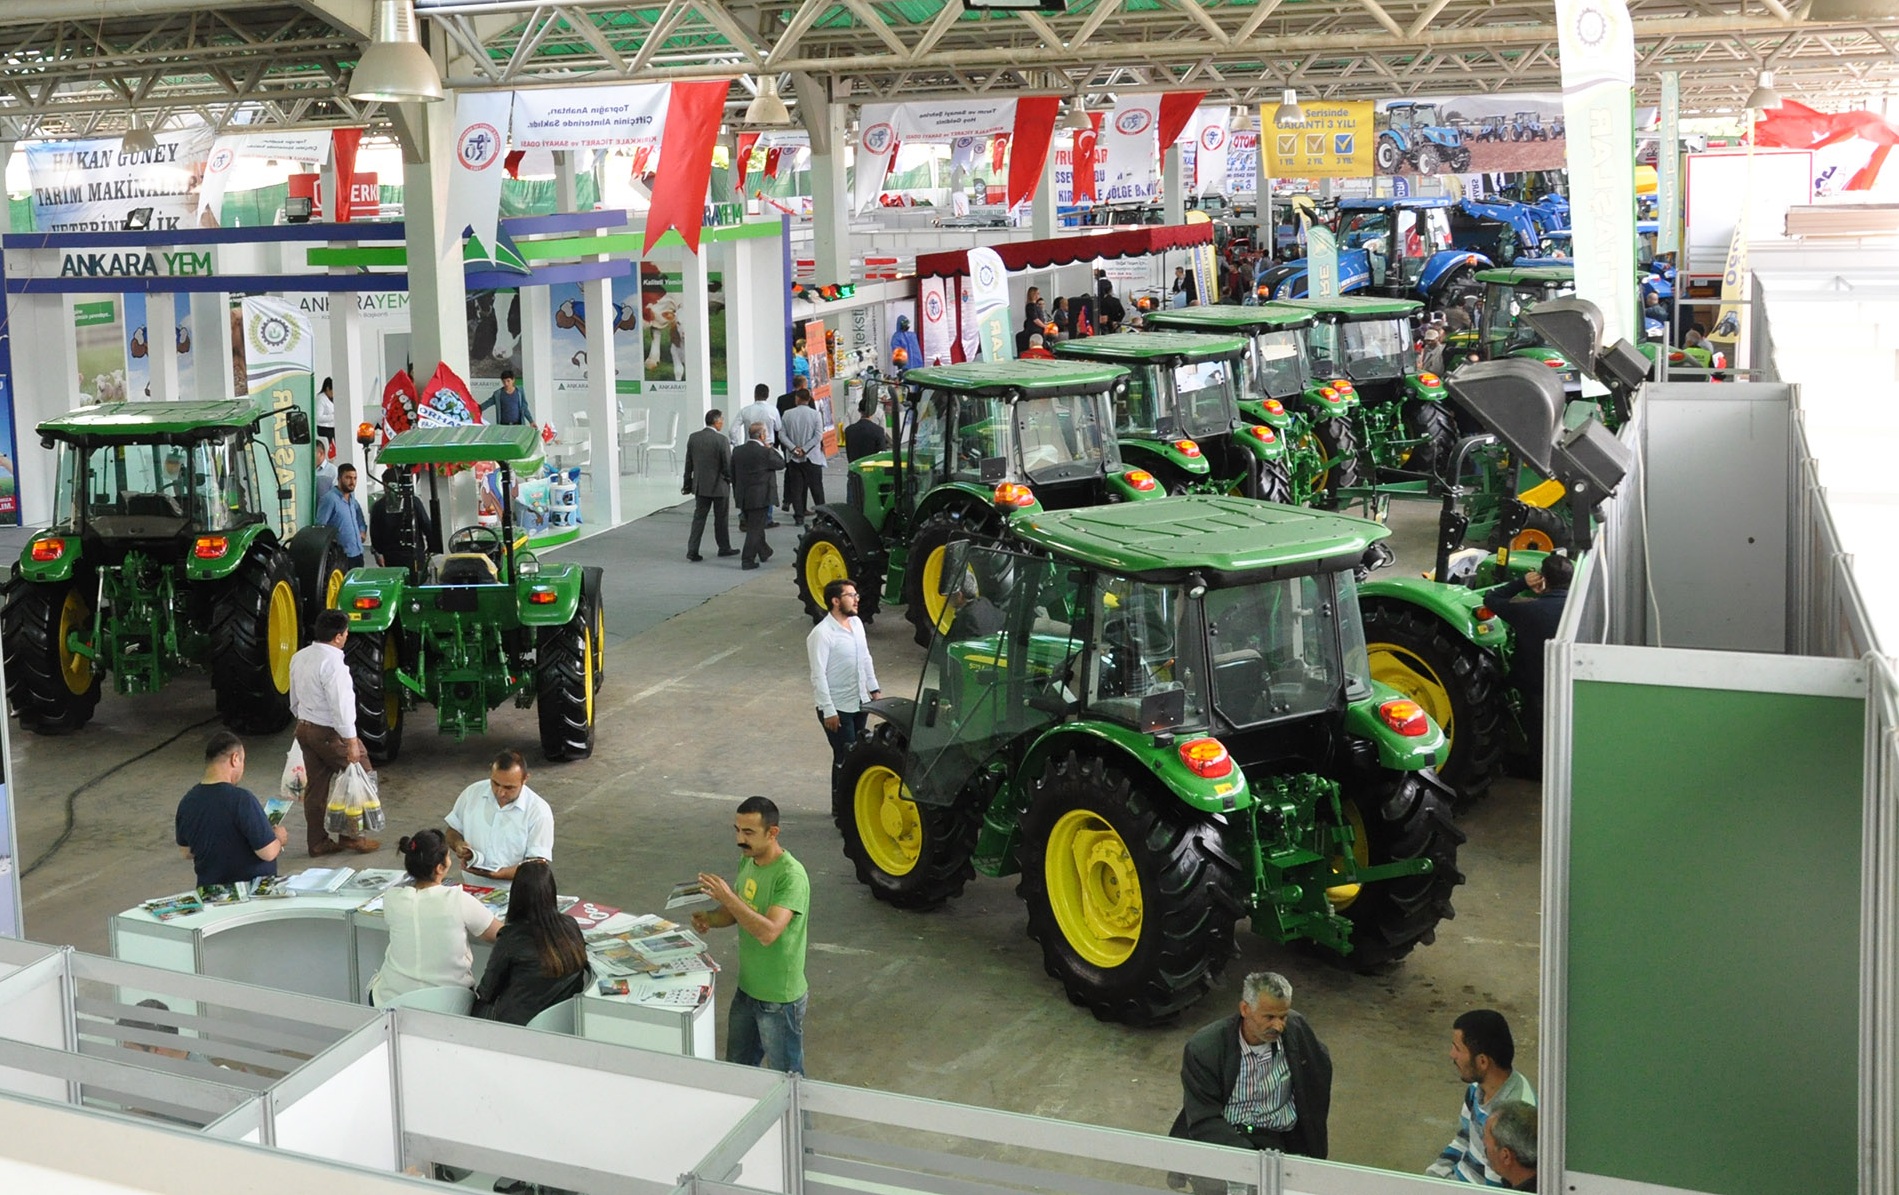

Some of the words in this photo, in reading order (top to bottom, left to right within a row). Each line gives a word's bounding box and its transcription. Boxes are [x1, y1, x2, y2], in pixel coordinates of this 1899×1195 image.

[1305, 108, 1349, 118] Serisinde
[1327, 119, 1334, 129] 3
[52, 149, 113, 172] HAKAN
[35, 184, 83, 207] TARIM
[61, 252, 159, 277] ANKARA
[162, 251, 214, 277] YEM
